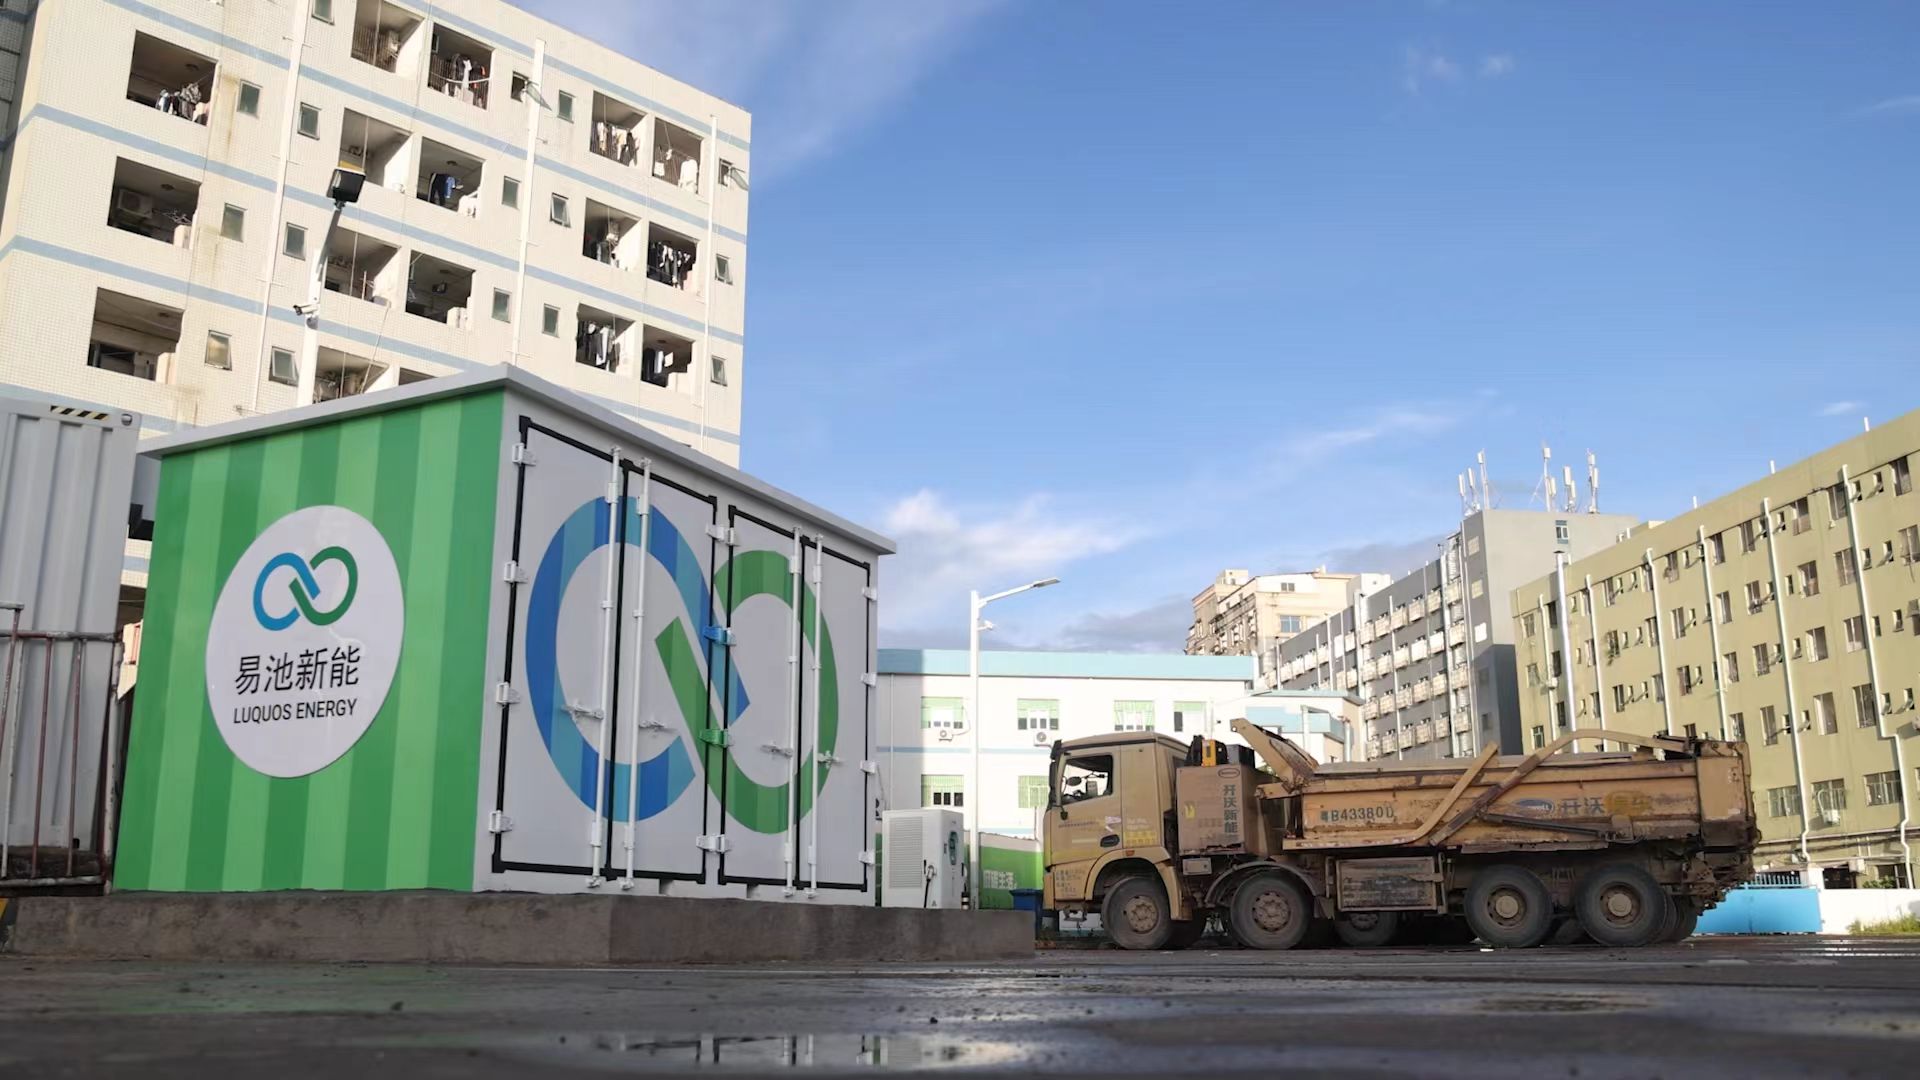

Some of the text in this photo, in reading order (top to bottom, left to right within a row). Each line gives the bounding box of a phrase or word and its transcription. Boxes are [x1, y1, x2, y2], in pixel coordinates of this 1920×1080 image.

[235, 645, 360, 695] 易池新能
[234, 699, 357, 724] LUQUOS ENERGY
[1222, 784, 1239, 844] 开沃新能
